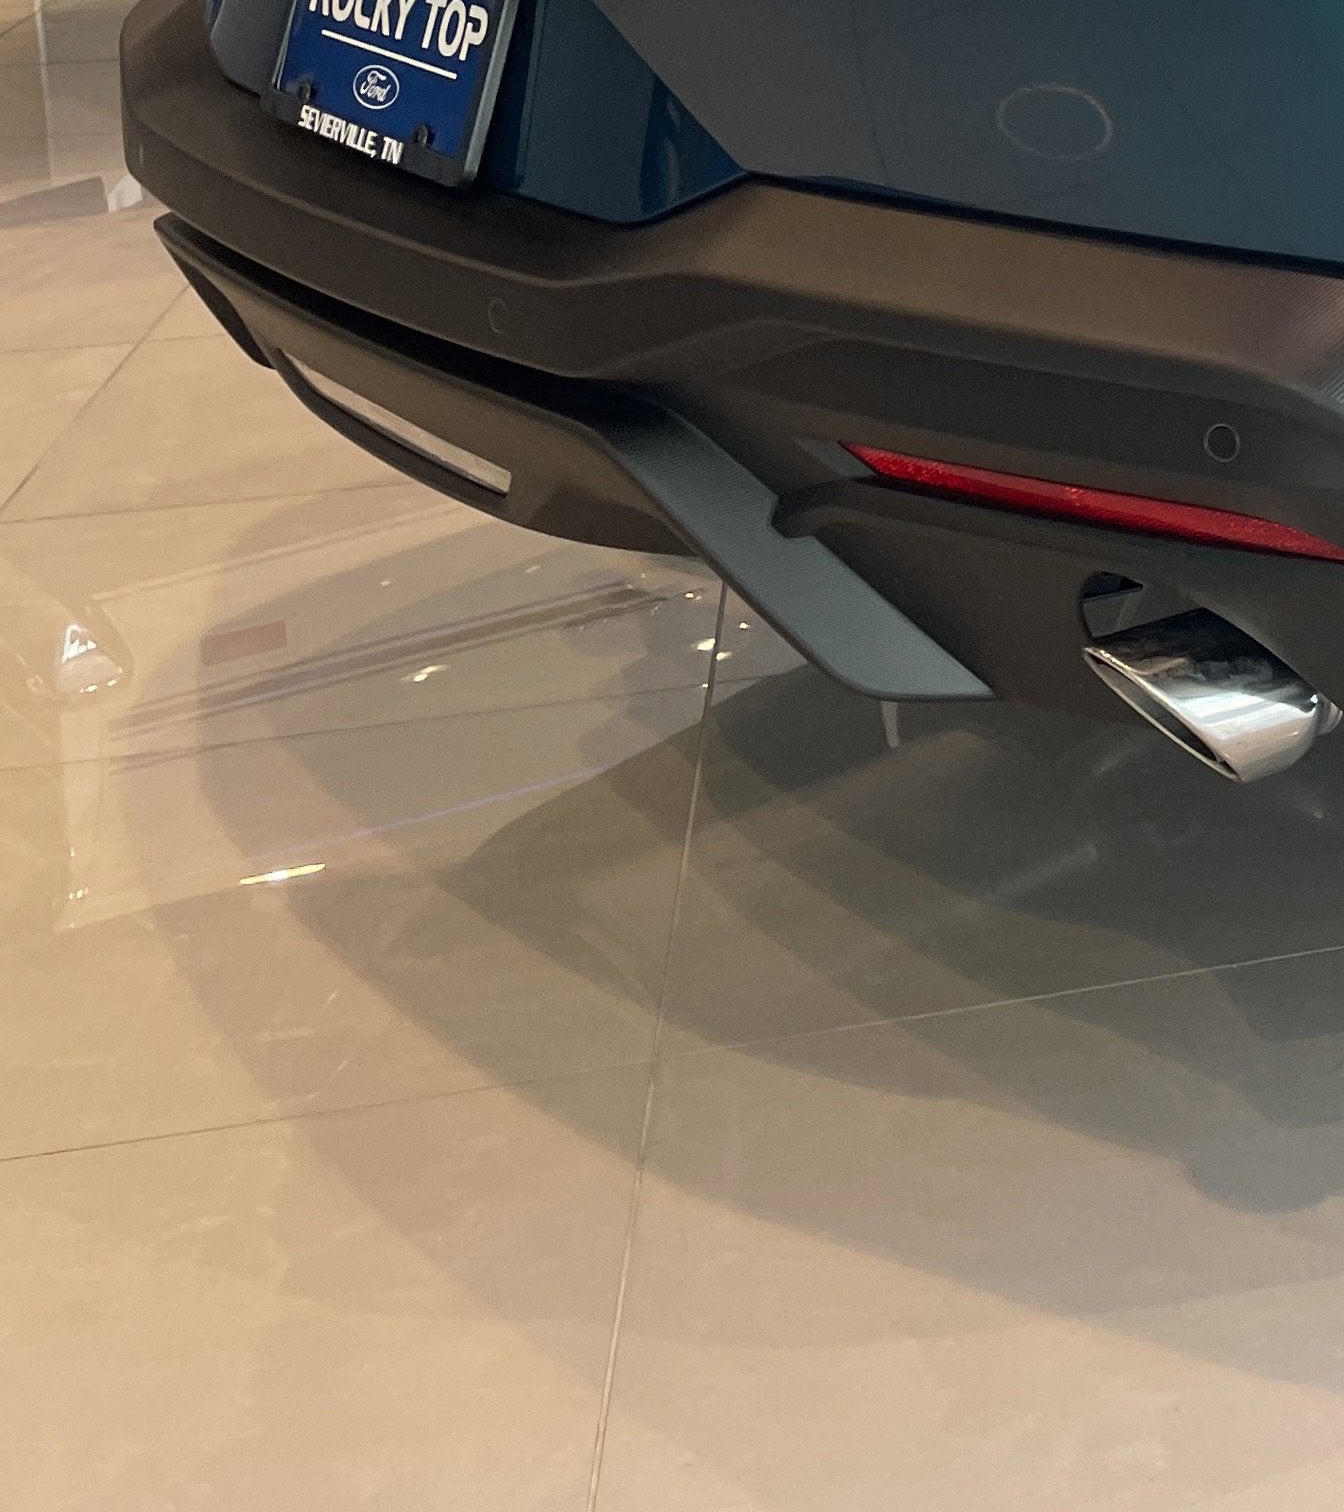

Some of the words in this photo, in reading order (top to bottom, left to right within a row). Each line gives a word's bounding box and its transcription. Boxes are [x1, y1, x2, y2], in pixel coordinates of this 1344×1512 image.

[359, 70, 391, 103] Ford
[297, 103, 378, 159] SEVIERVILLE,
[380, 135, 405, 165] TN
